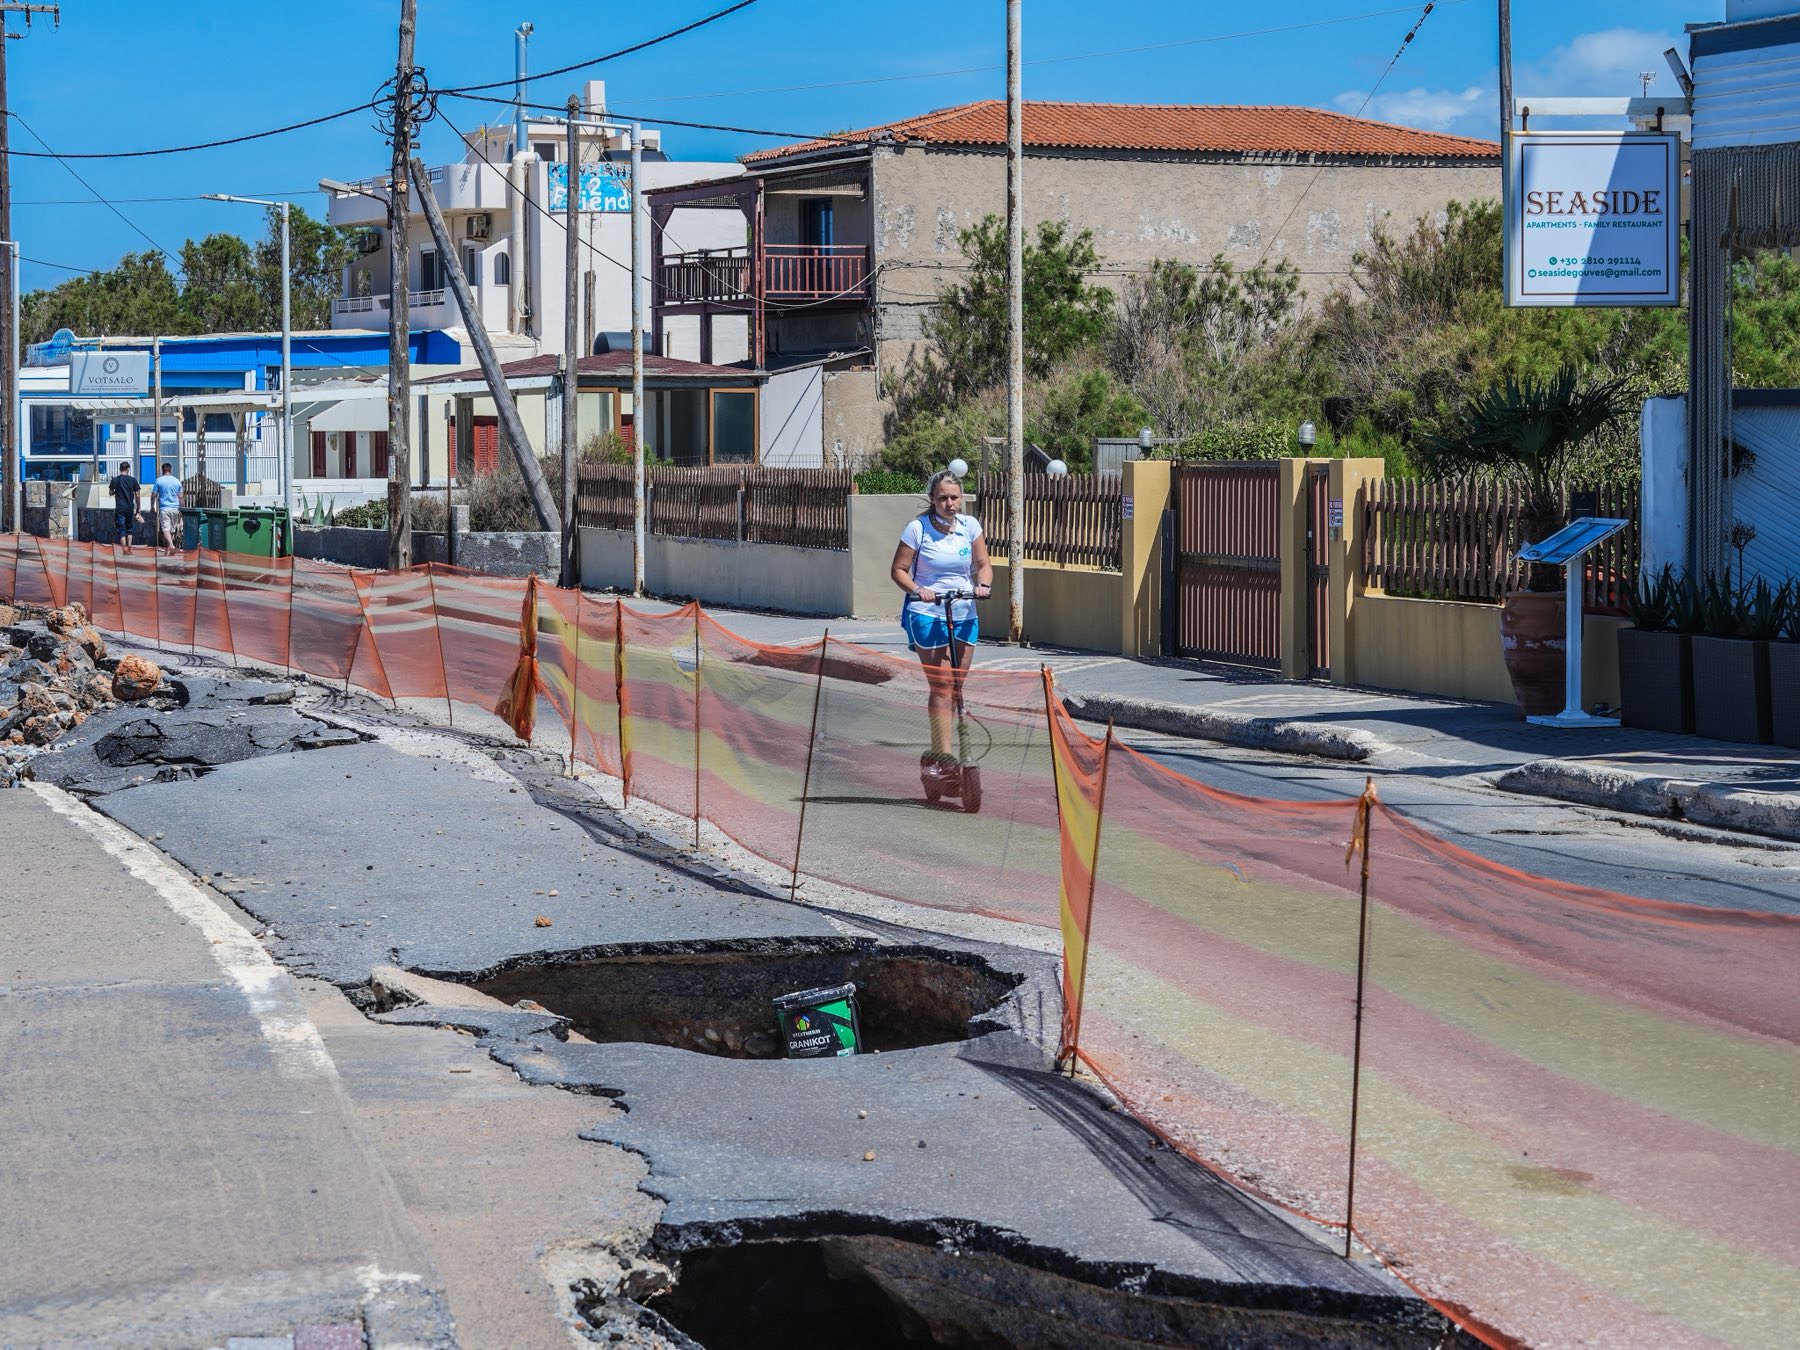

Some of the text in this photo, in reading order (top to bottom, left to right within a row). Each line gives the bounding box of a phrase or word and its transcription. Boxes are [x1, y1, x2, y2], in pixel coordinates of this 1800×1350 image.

[590, 177, 602, 196] 2
[1526, 190, 1663, 216] SEASIDE
[1560, 256, 1641, 265] +30 2810 291114
[1538, 268, 1662, 278] seasidegouves@gmail.com
[789, 1034, 831, 1049] GRANIKOT
